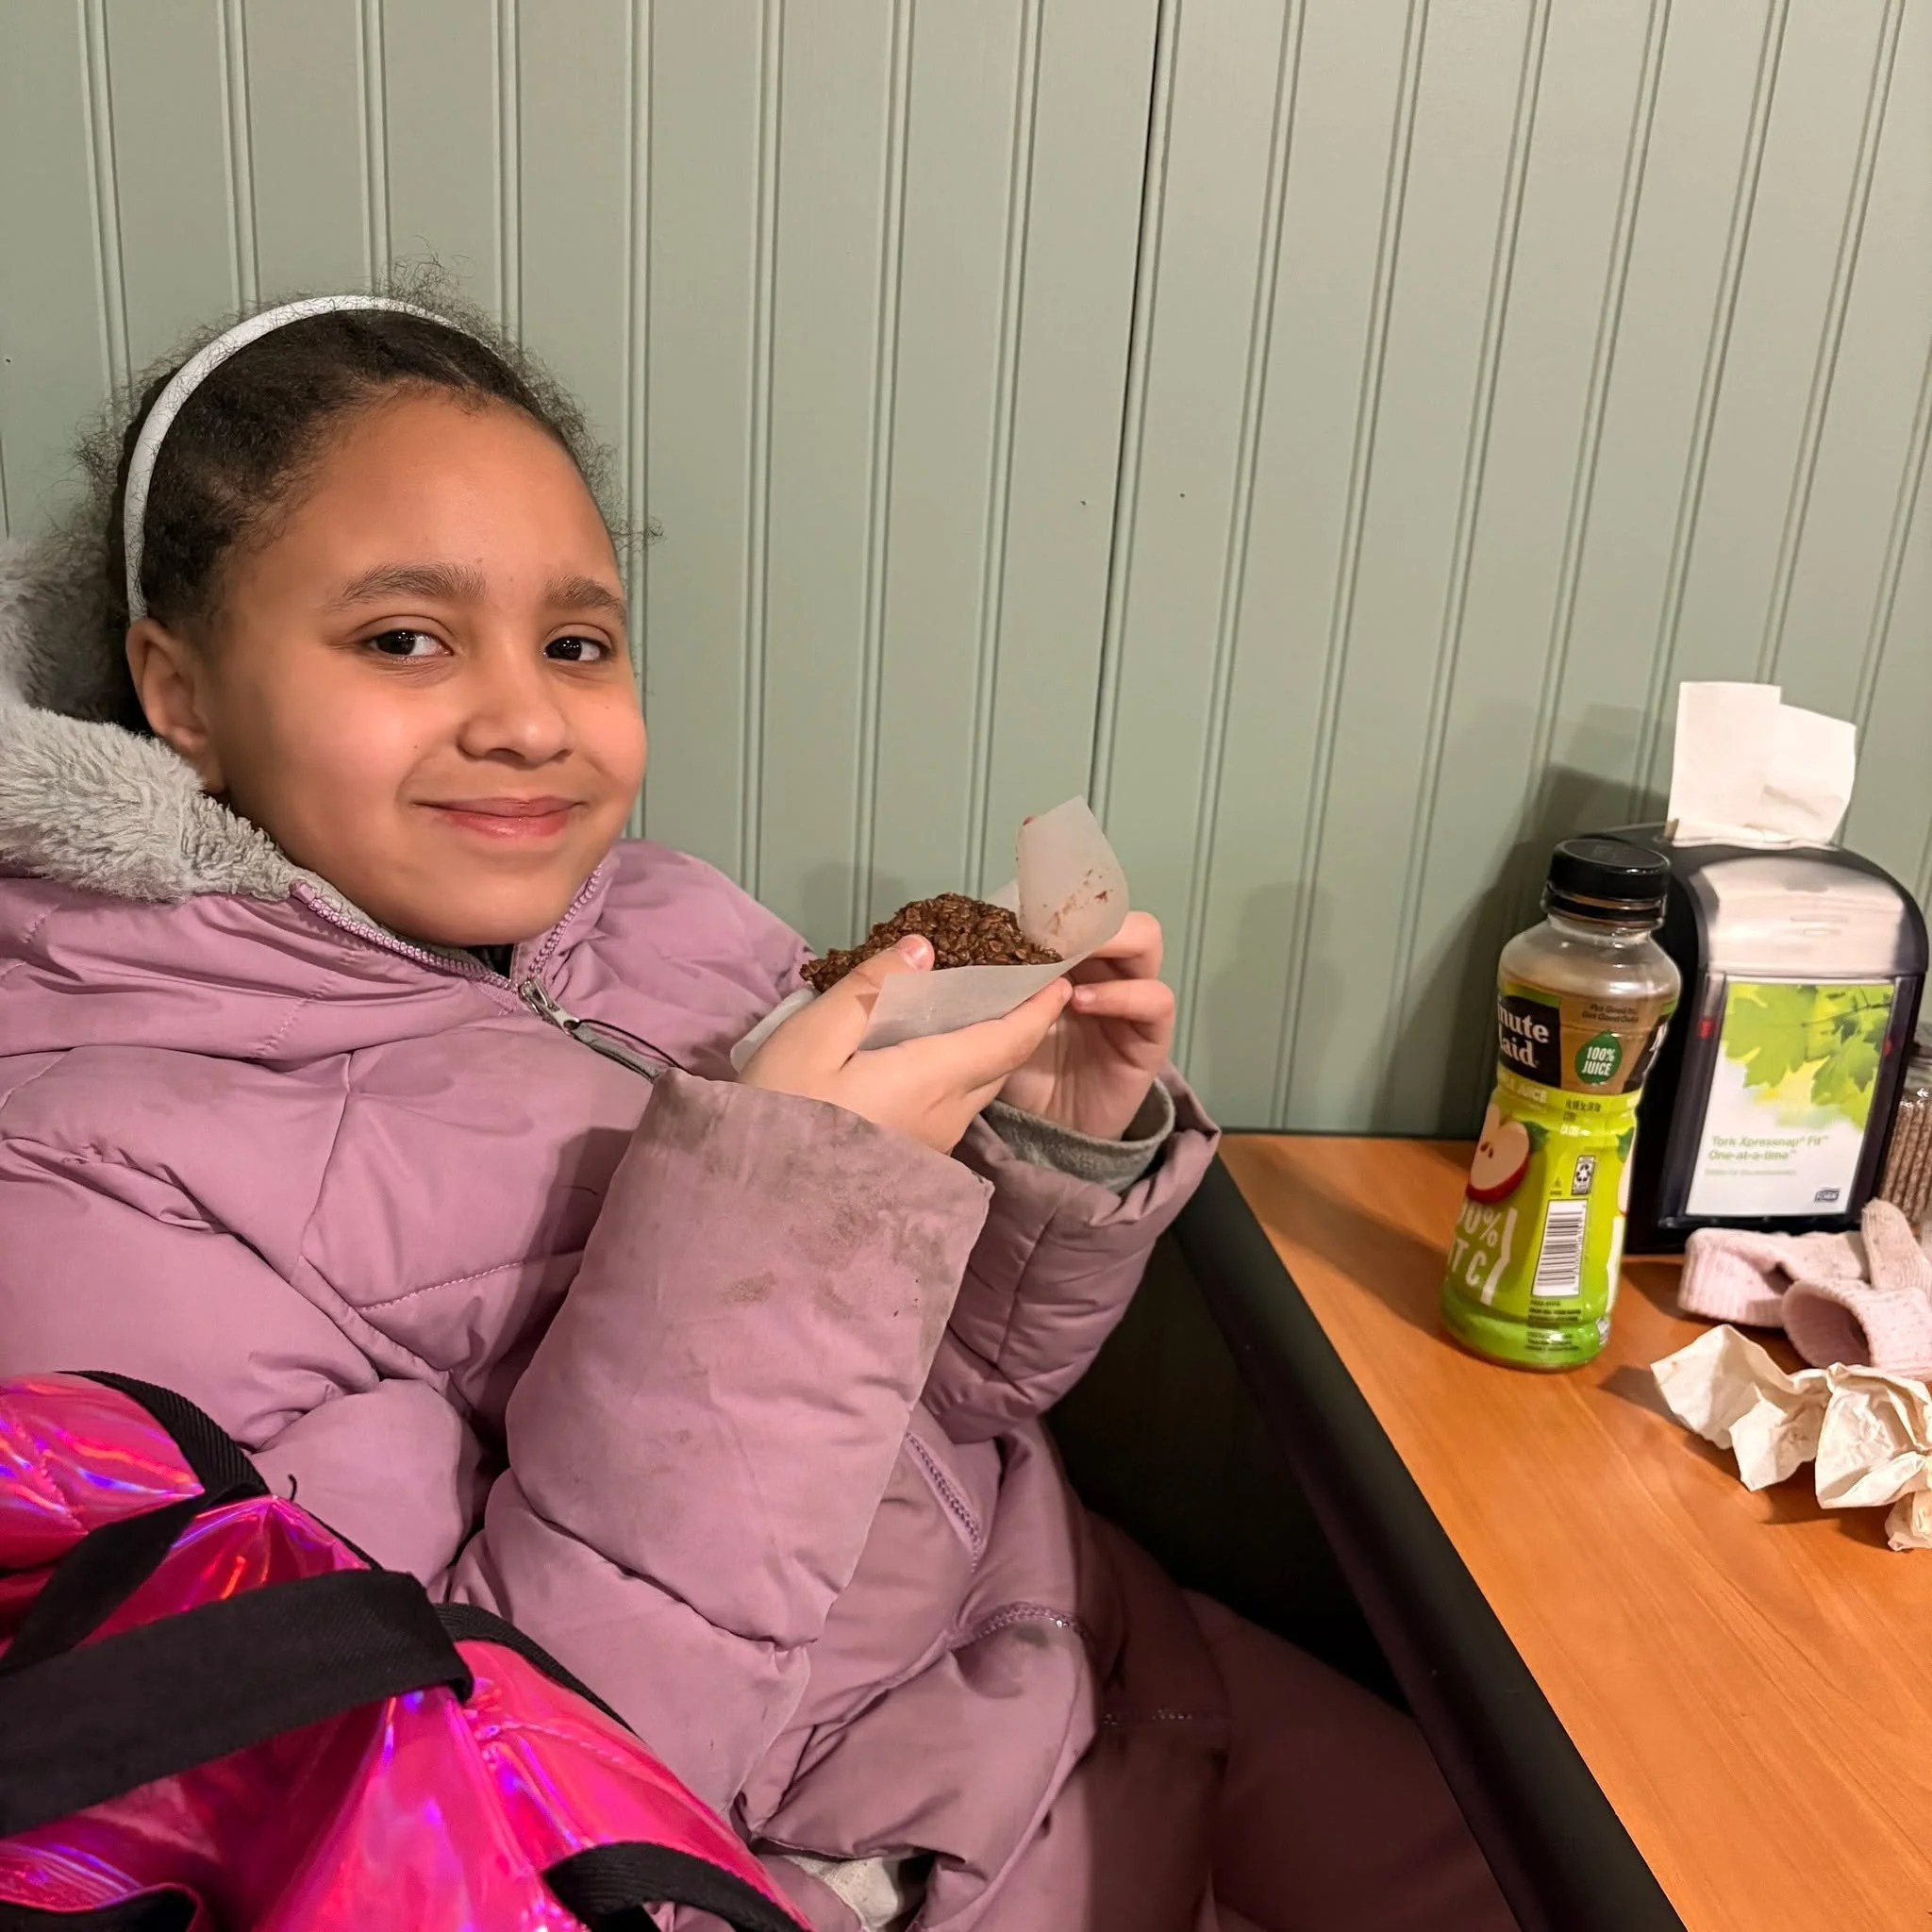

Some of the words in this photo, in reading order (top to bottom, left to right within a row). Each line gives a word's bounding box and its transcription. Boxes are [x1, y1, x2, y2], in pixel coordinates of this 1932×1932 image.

[1497, 1004, 1550, 1043] nute
[1587, 1046, 1616, 1062] 100%
[1581, 1060, 1612, 1076] JUICE
[1712, 1135, 1736, 1146] Tork
